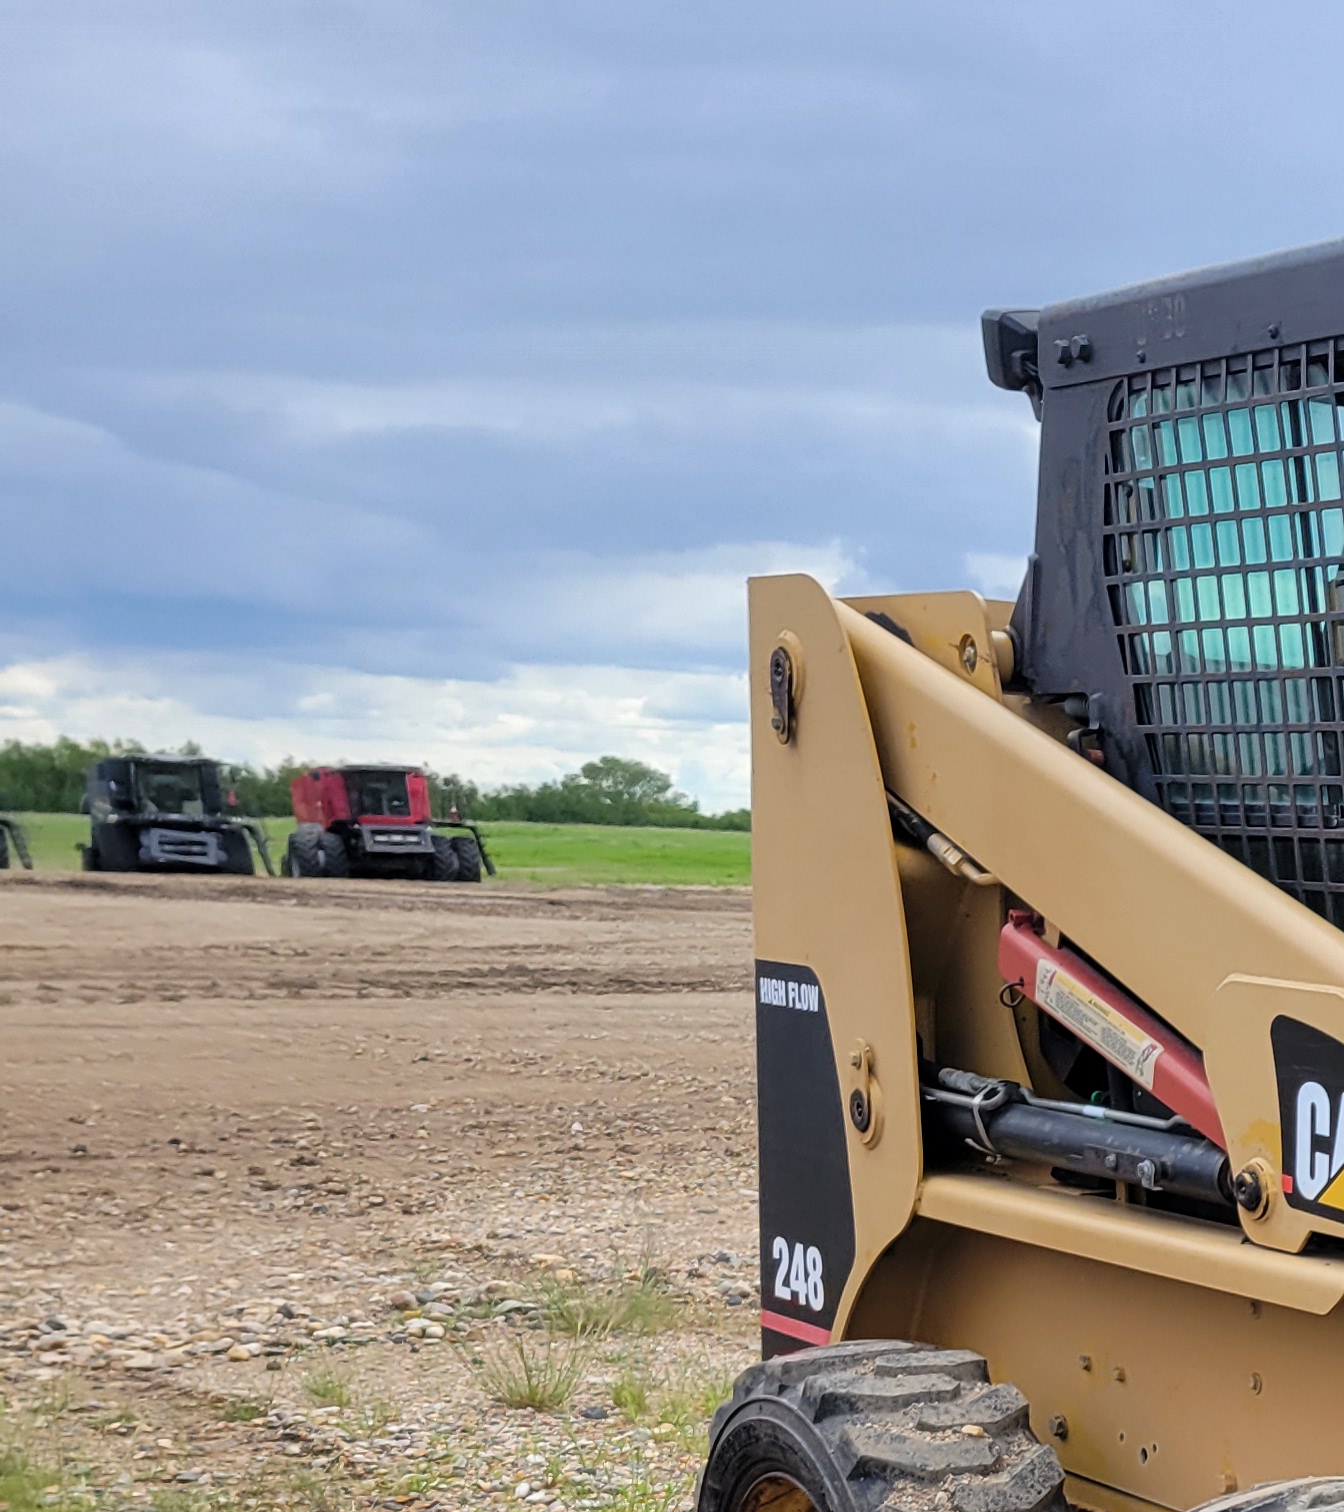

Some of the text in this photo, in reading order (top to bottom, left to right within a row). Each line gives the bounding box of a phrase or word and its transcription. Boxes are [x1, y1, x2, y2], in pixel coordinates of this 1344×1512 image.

[760, 976, 819, 1013] HIGH FLOW
[772, 1235, 825, 1312] 248
